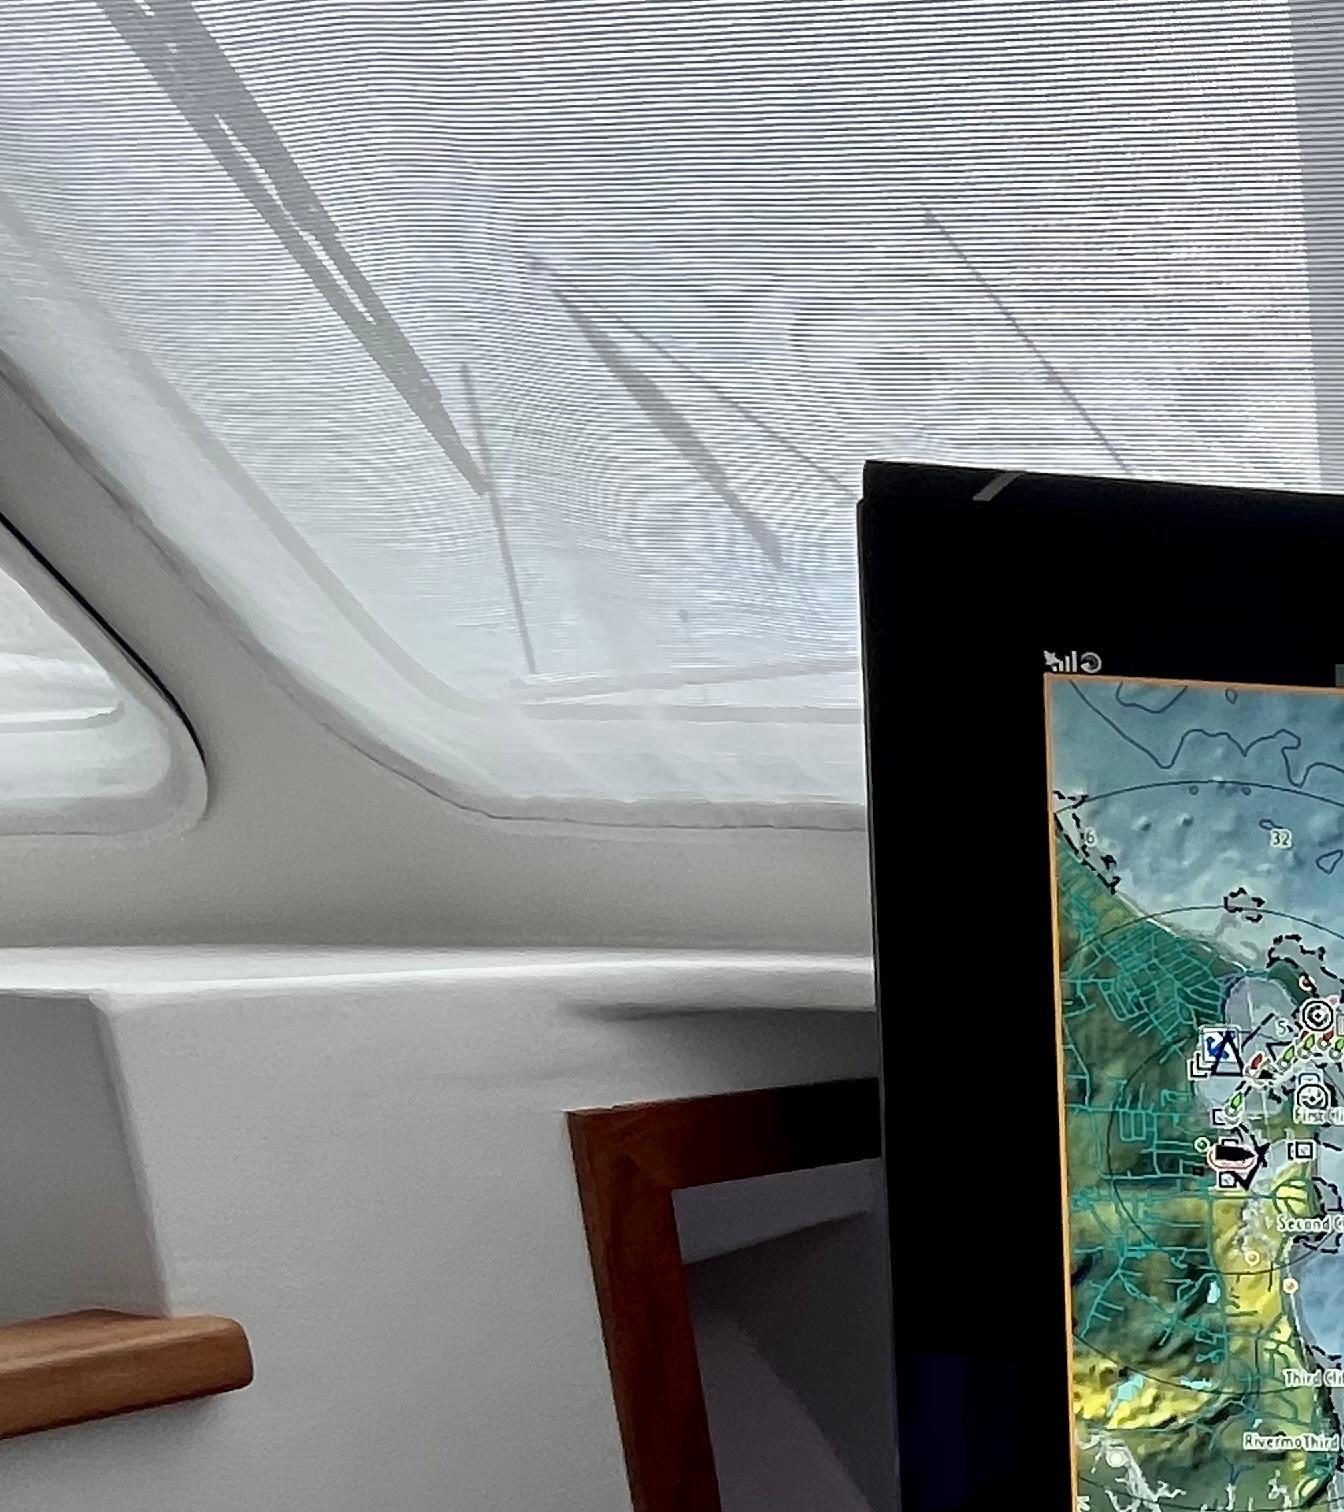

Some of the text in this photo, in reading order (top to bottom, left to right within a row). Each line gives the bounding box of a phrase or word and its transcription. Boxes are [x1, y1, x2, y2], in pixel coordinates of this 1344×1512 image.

[1271, 829, 1291, 848] 32
[1279, 1214, 1330, 1231] Second
[1286, 1370, 1322, 1386] Third
[1303, 1434, 1338, 1450] Third
